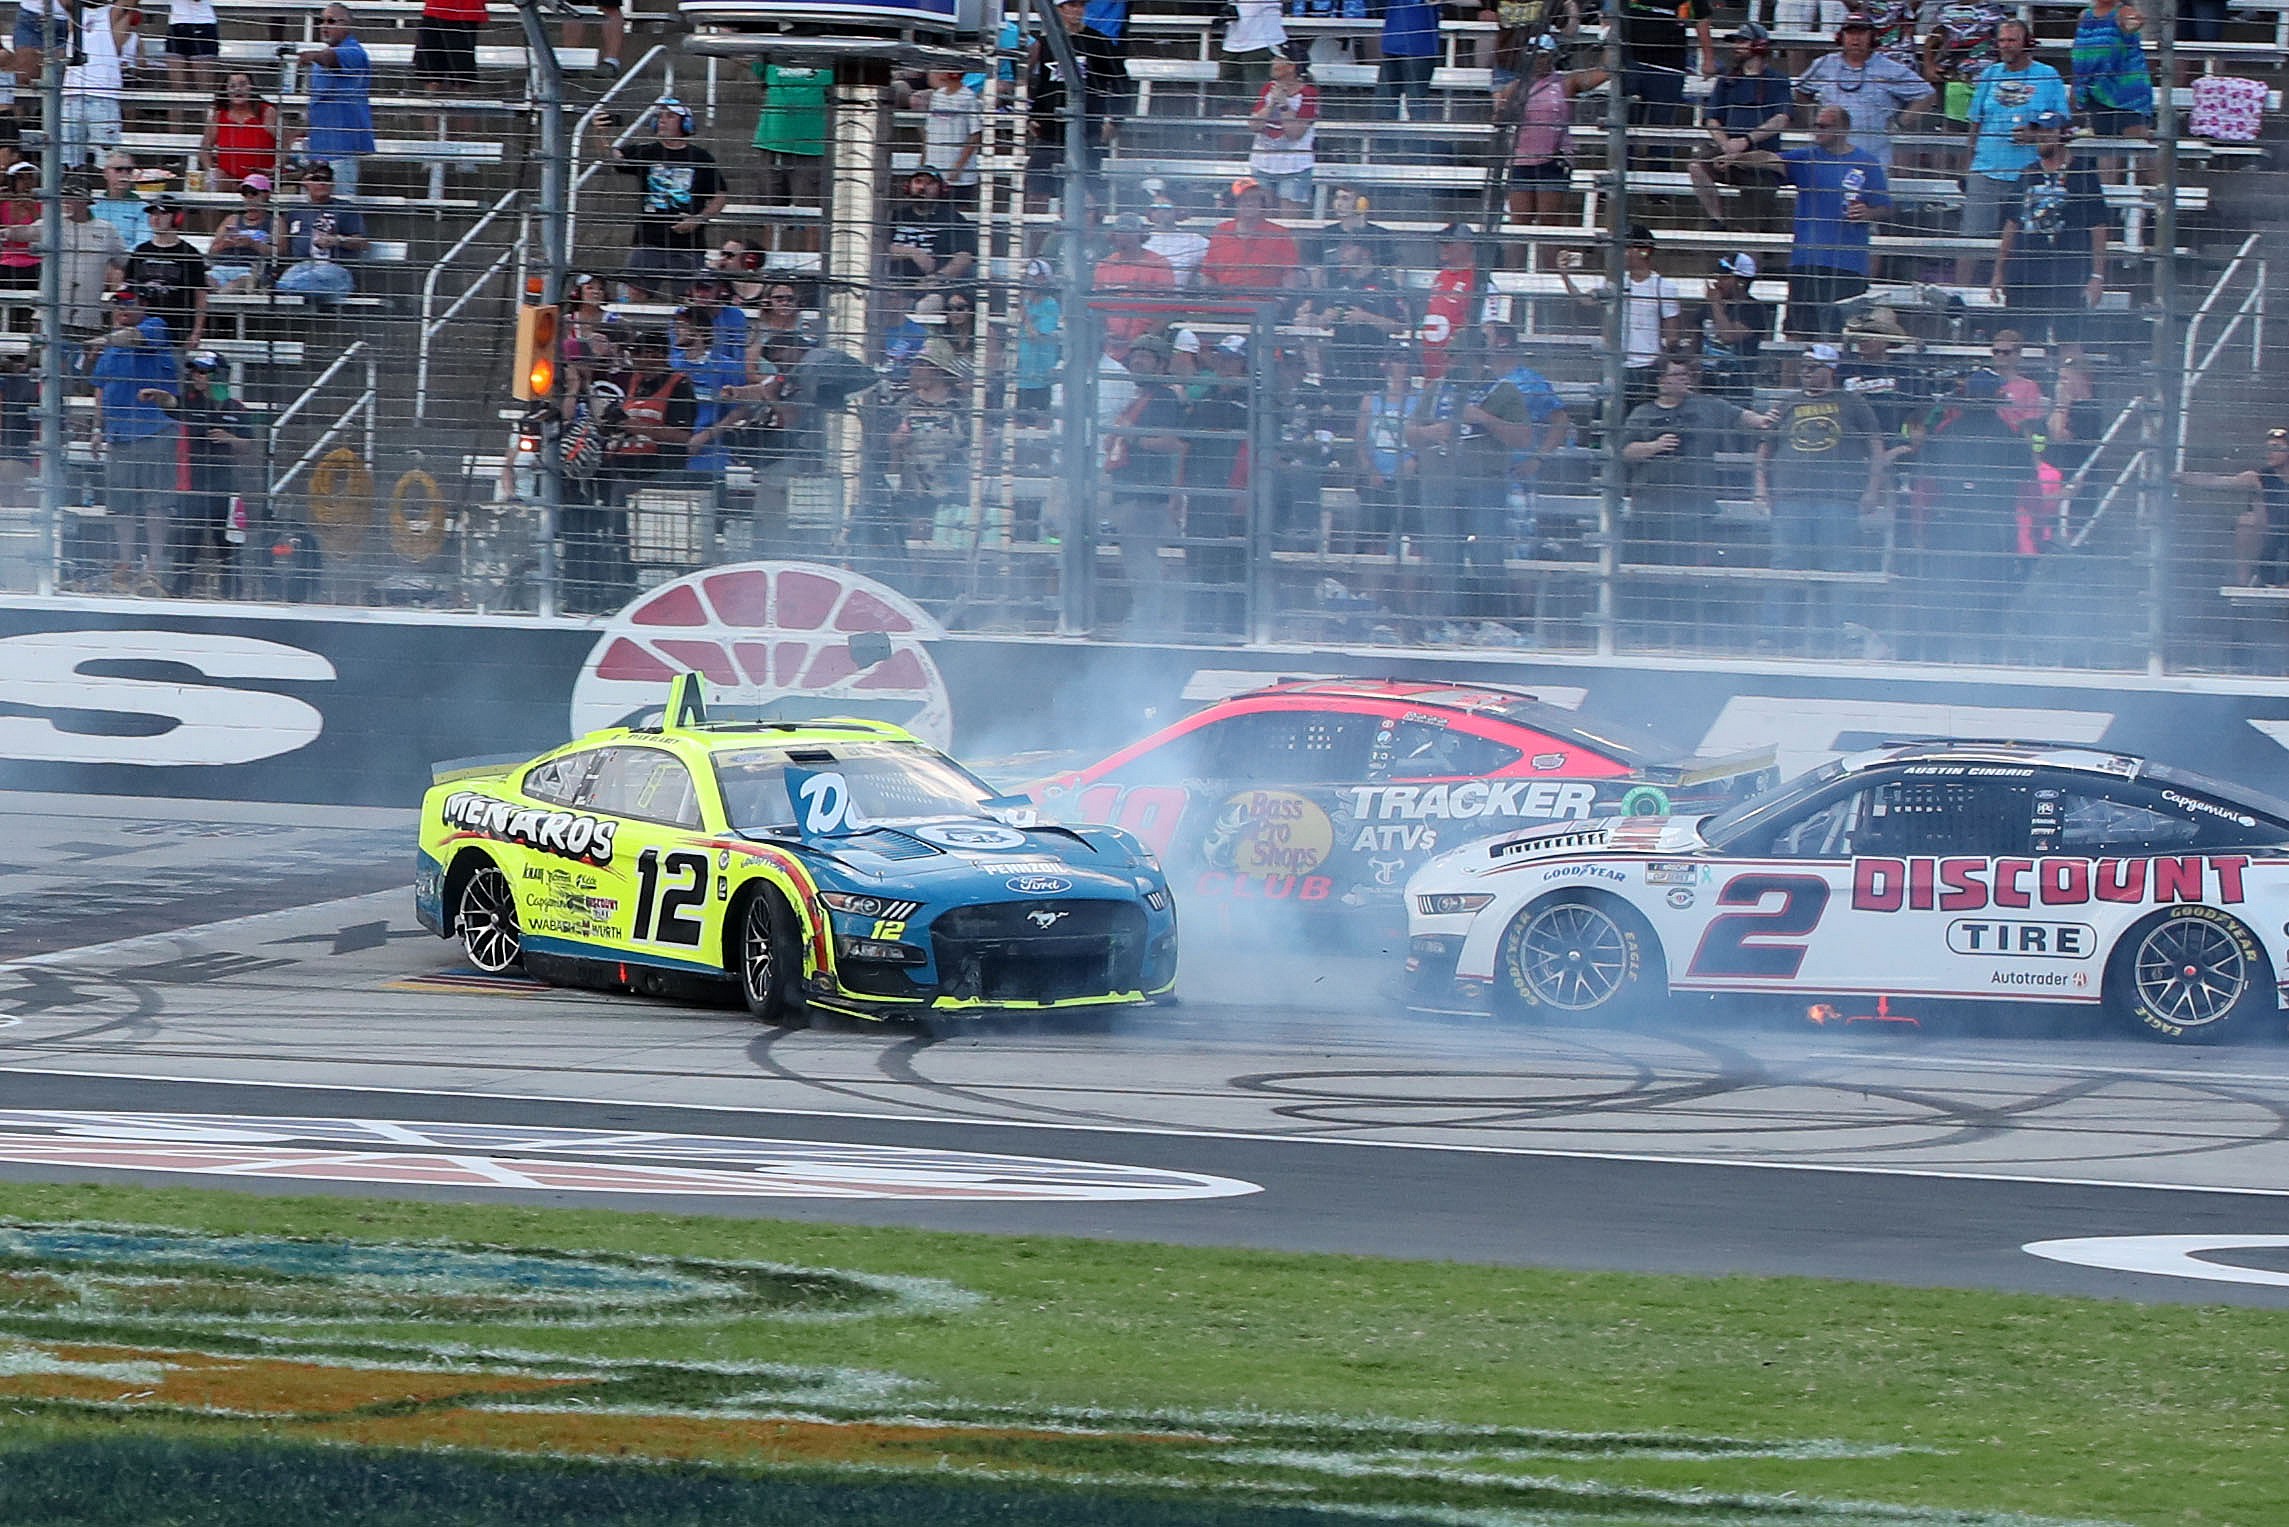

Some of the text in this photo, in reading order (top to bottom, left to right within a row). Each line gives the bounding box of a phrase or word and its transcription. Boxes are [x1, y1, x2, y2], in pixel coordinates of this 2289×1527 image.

[1903, 767, 1963, 775] AUSTIN
[1250, 791, 1304, 818] Bass
[1350, 782, 1597, 820] TRACKER
[2161, 789, 2240, 822] Capgemini
[1253, 818, 1291, 842] Pro
[1351, 825, 1437, 852] ATVs
[983, 862, 1069, 876] PENNZOIL
[1251, 840, 1319, 875] Shops
[1195, 871, 1334, 900] CLUB
[1543, 863, 1626, 882] GOODYEAR
[1851, 856, 2250, 912] DISCOUNT
[633, 849, 709, 946] 12
[871, 921, 906, 940] 12
[1685, 873, 1831, 979] 2
[1962, 924, 2080, 954] TIRE
[2170, 905, 2257, 962] GOODYEAR
[1991, 970, 2068, 986] Autotrader
[2134, 1006, 2183, 1036] EAGLE
